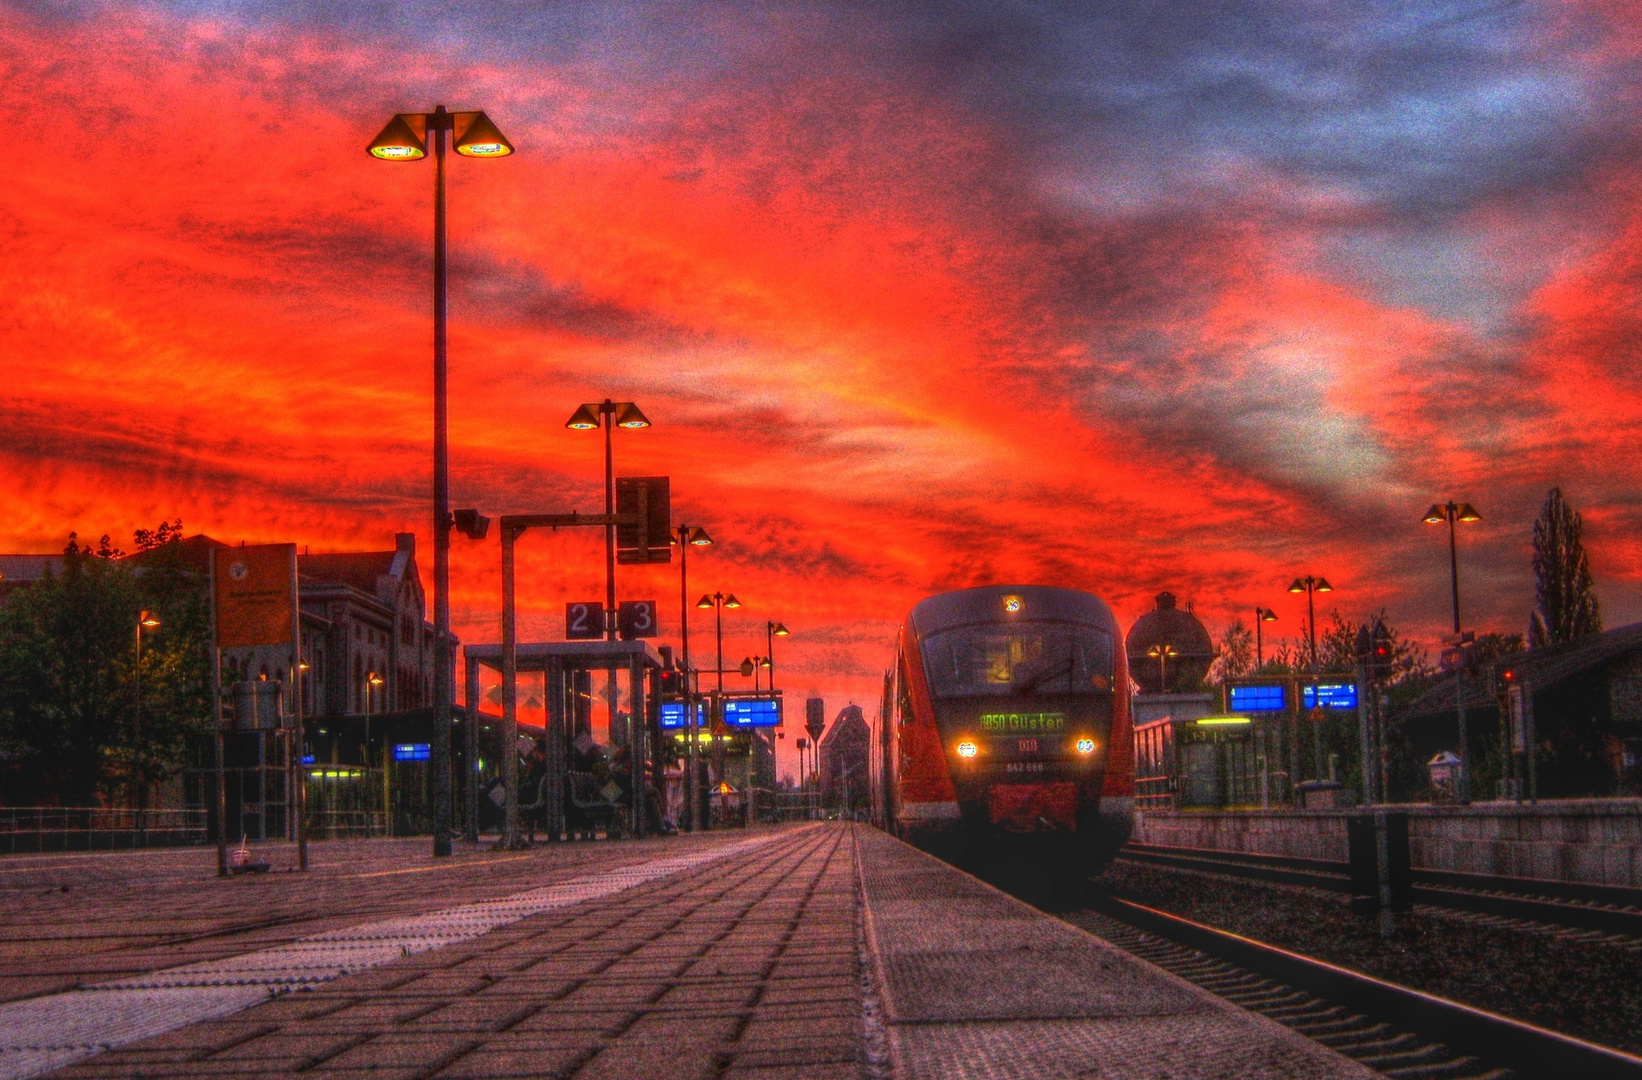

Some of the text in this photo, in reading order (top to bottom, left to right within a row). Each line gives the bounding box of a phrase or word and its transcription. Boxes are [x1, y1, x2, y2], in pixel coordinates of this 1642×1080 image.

[571, 604, 588, 631] 2
[634, 602, 651, 629] 3
[1348, 684, 1354, 693] 5
[771, 701, 777, 710] 3
[1019, 739, 1037, 752] DB
